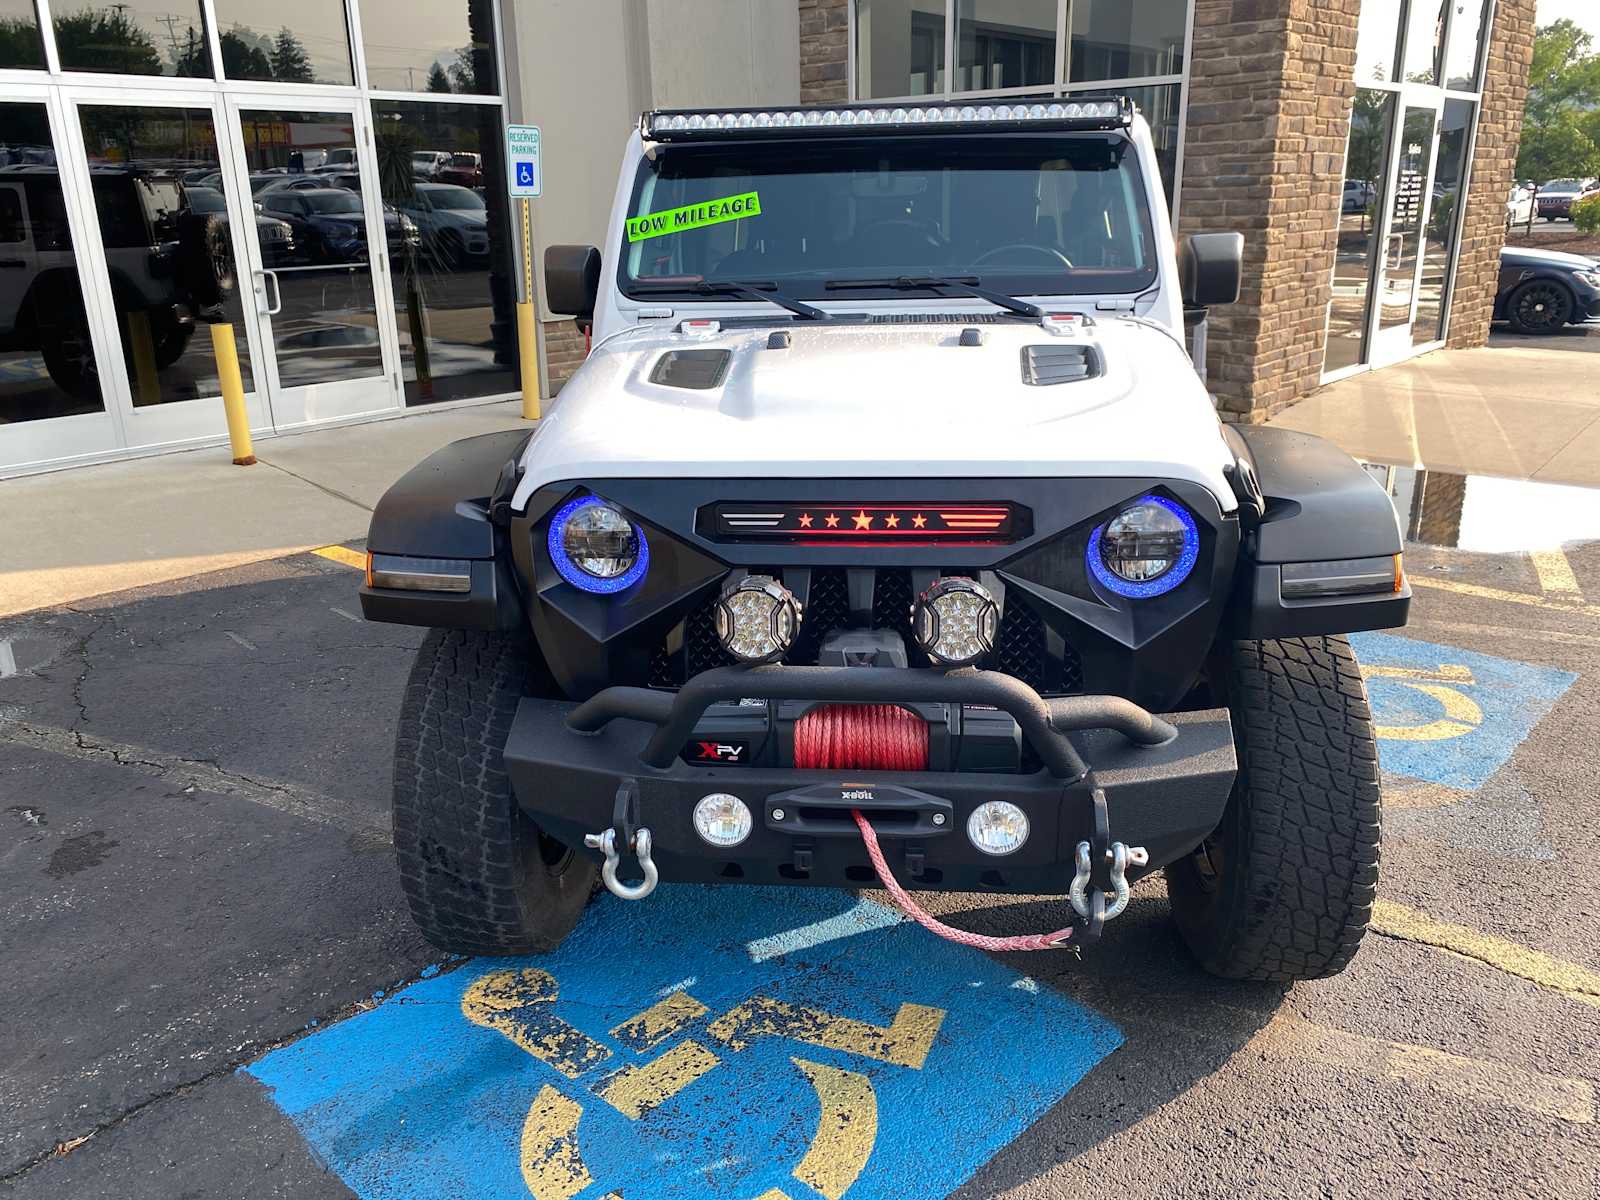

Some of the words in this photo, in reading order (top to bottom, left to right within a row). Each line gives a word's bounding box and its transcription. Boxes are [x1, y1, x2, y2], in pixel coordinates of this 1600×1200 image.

[510, 132, 538, 143] RESERVED
[512, 145, 537, 155] PARKING
[630, 215, 667, 236] LOW
[674, 197, 755, 227] MILEAGE
[841, 789, 874, 800] X-BULL
